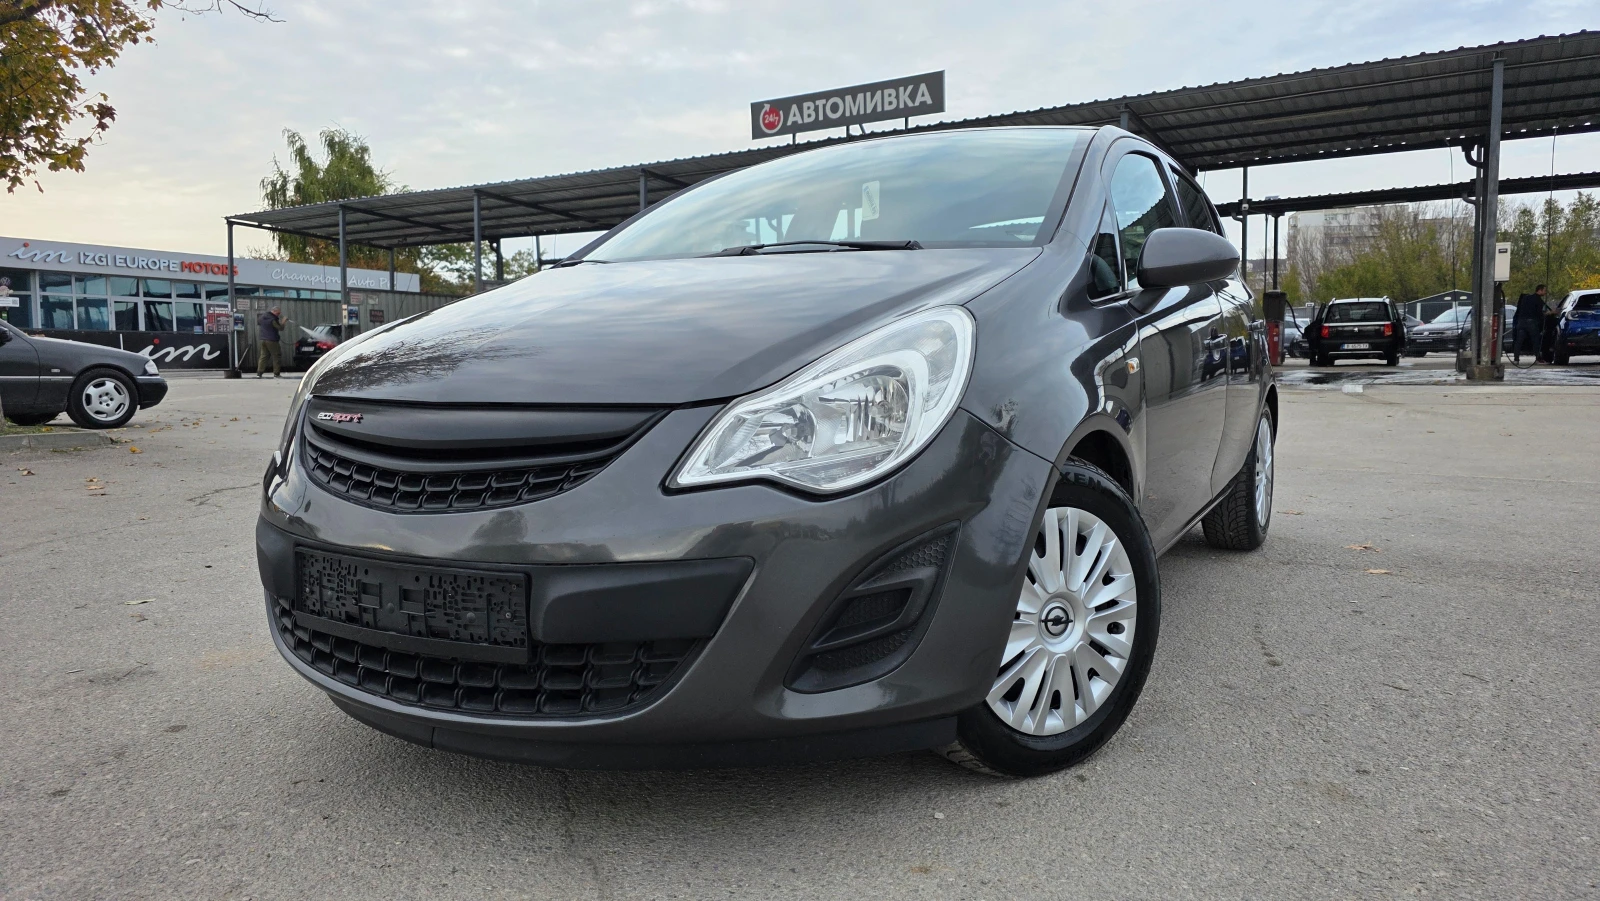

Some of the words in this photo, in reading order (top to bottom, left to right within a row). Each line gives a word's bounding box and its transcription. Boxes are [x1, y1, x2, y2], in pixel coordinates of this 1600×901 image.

[764, 112, 779, 126] 24/7
[786, 82, 933, 126] АВТОМИВКА
[78, 252, 112, 267] IZGI
[115, 252, 180, 272] EUROPE
[271, 268, 341, 285] Champion
[348, 276, 375, 287] Auto
